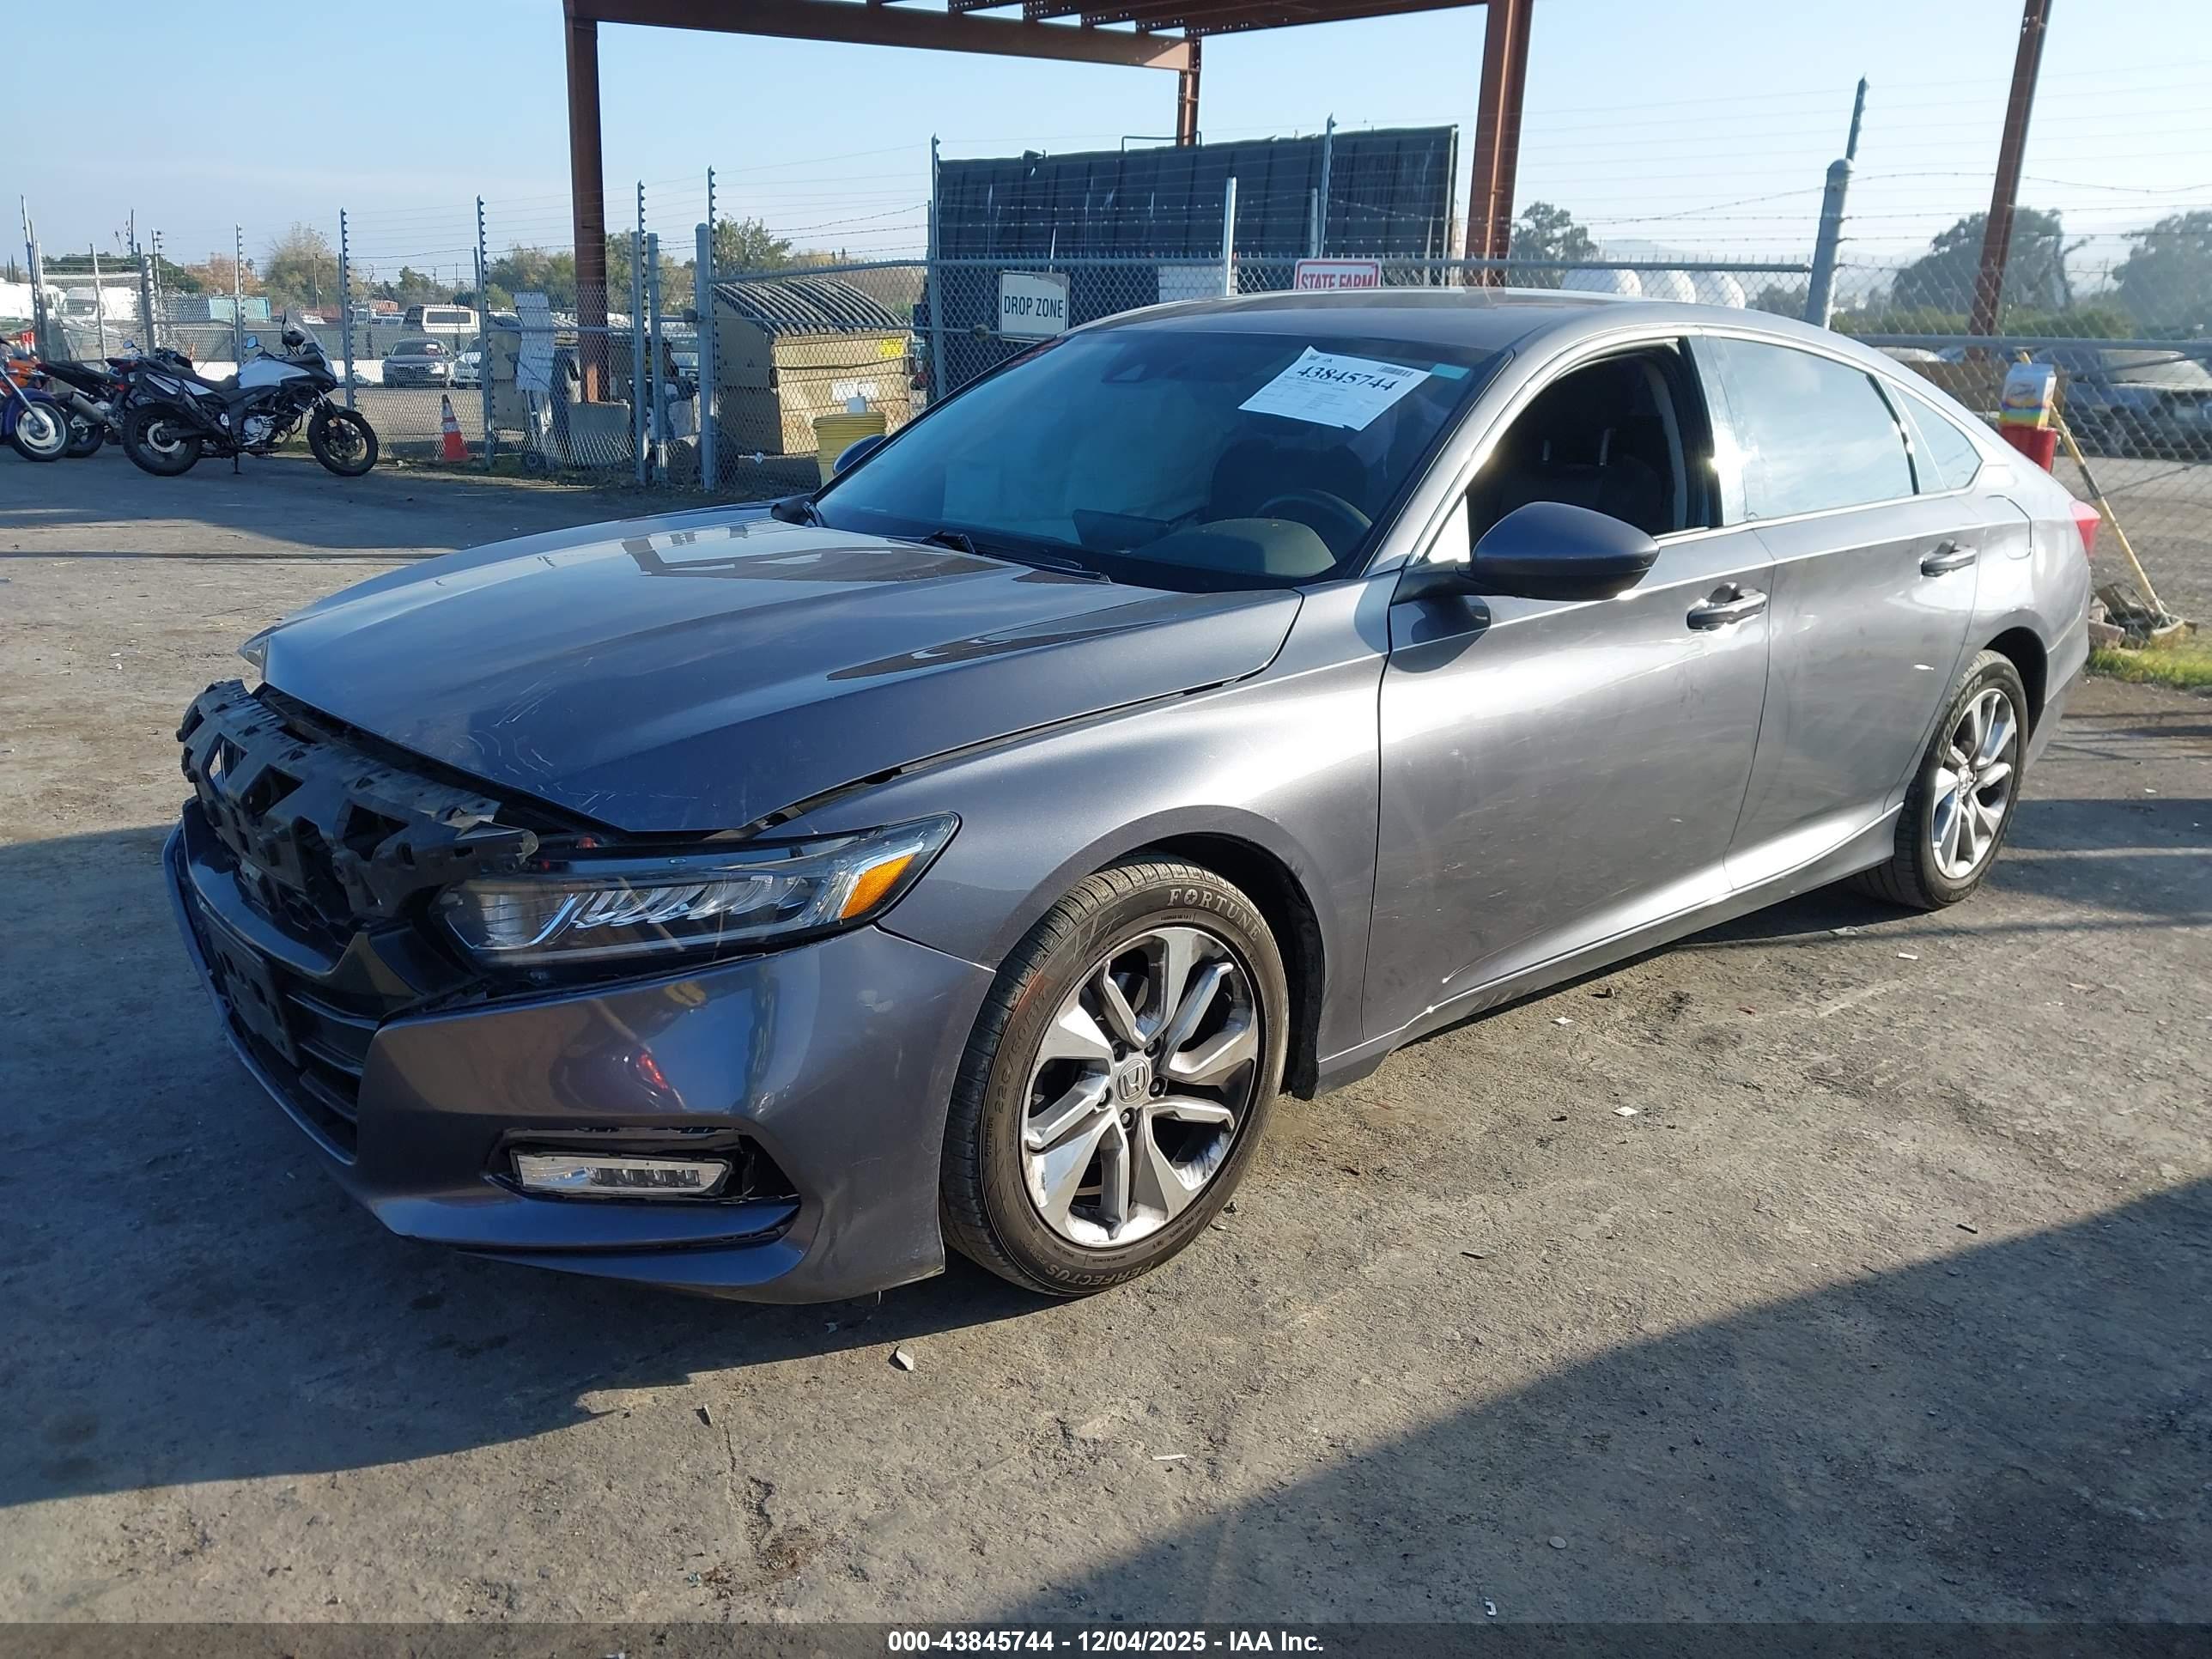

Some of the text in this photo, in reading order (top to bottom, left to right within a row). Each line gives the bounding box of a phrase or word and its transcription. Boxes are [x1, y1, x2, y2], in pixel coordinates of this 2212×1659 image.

[1301, 273, 1373, 289] STATE FARM
[1004, 295, 1064, 319] DROP ZONE
[1297, 365, 1400, 392] 43845744
[1168, 888, 1261, 942] FORTUNE
[1045, 1260, 1155, 1286] PERFECTUS
